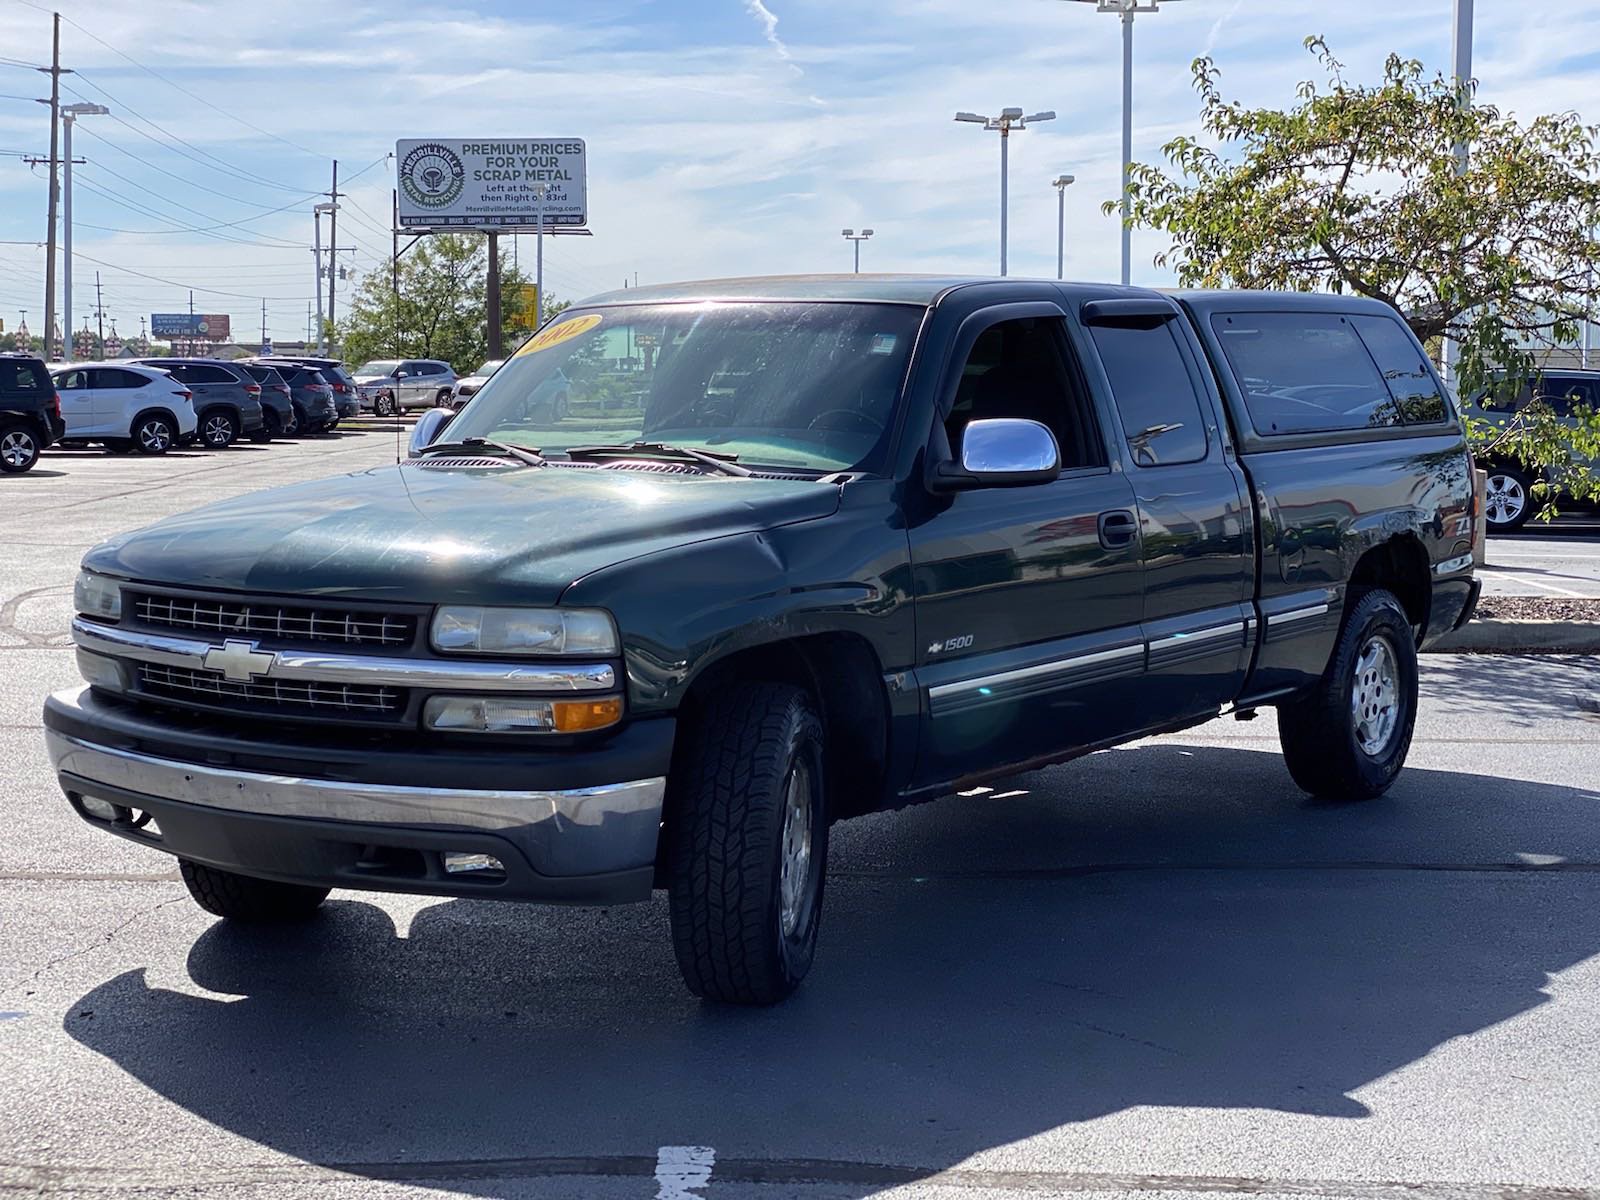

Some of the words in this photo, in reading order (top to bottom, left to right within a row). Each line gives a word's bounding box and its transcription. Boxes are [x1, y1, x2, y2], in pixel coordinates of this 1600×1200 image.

[462, 144, 528, 155] PREMIUM
[531, 143, 582, 155] PRICES
[403, 147, 461, 174] MERRILLVILLE
[486, 157, 516, 168] FOR
[519, 157, 559, 168] YOUR
[473, 170, 521, 181] SCRAP
[525, 169, 573, 181] METAL
[403, 179, 423, 201] METAL
[424, 180, 461, 204] RECYCLING
[486, 184, 505, 192] Left
[507, 184, 517, 192] at
[520, 184, 535, 192] the
[481, 194, 502, 202] then
[504, 194, 530, 203] Right
[546, 193, 568, 201] 83rd
[465, 205, 581, 213] MerrillvilleMetalReccling.com
[945, 634, 973, 651] 1500
